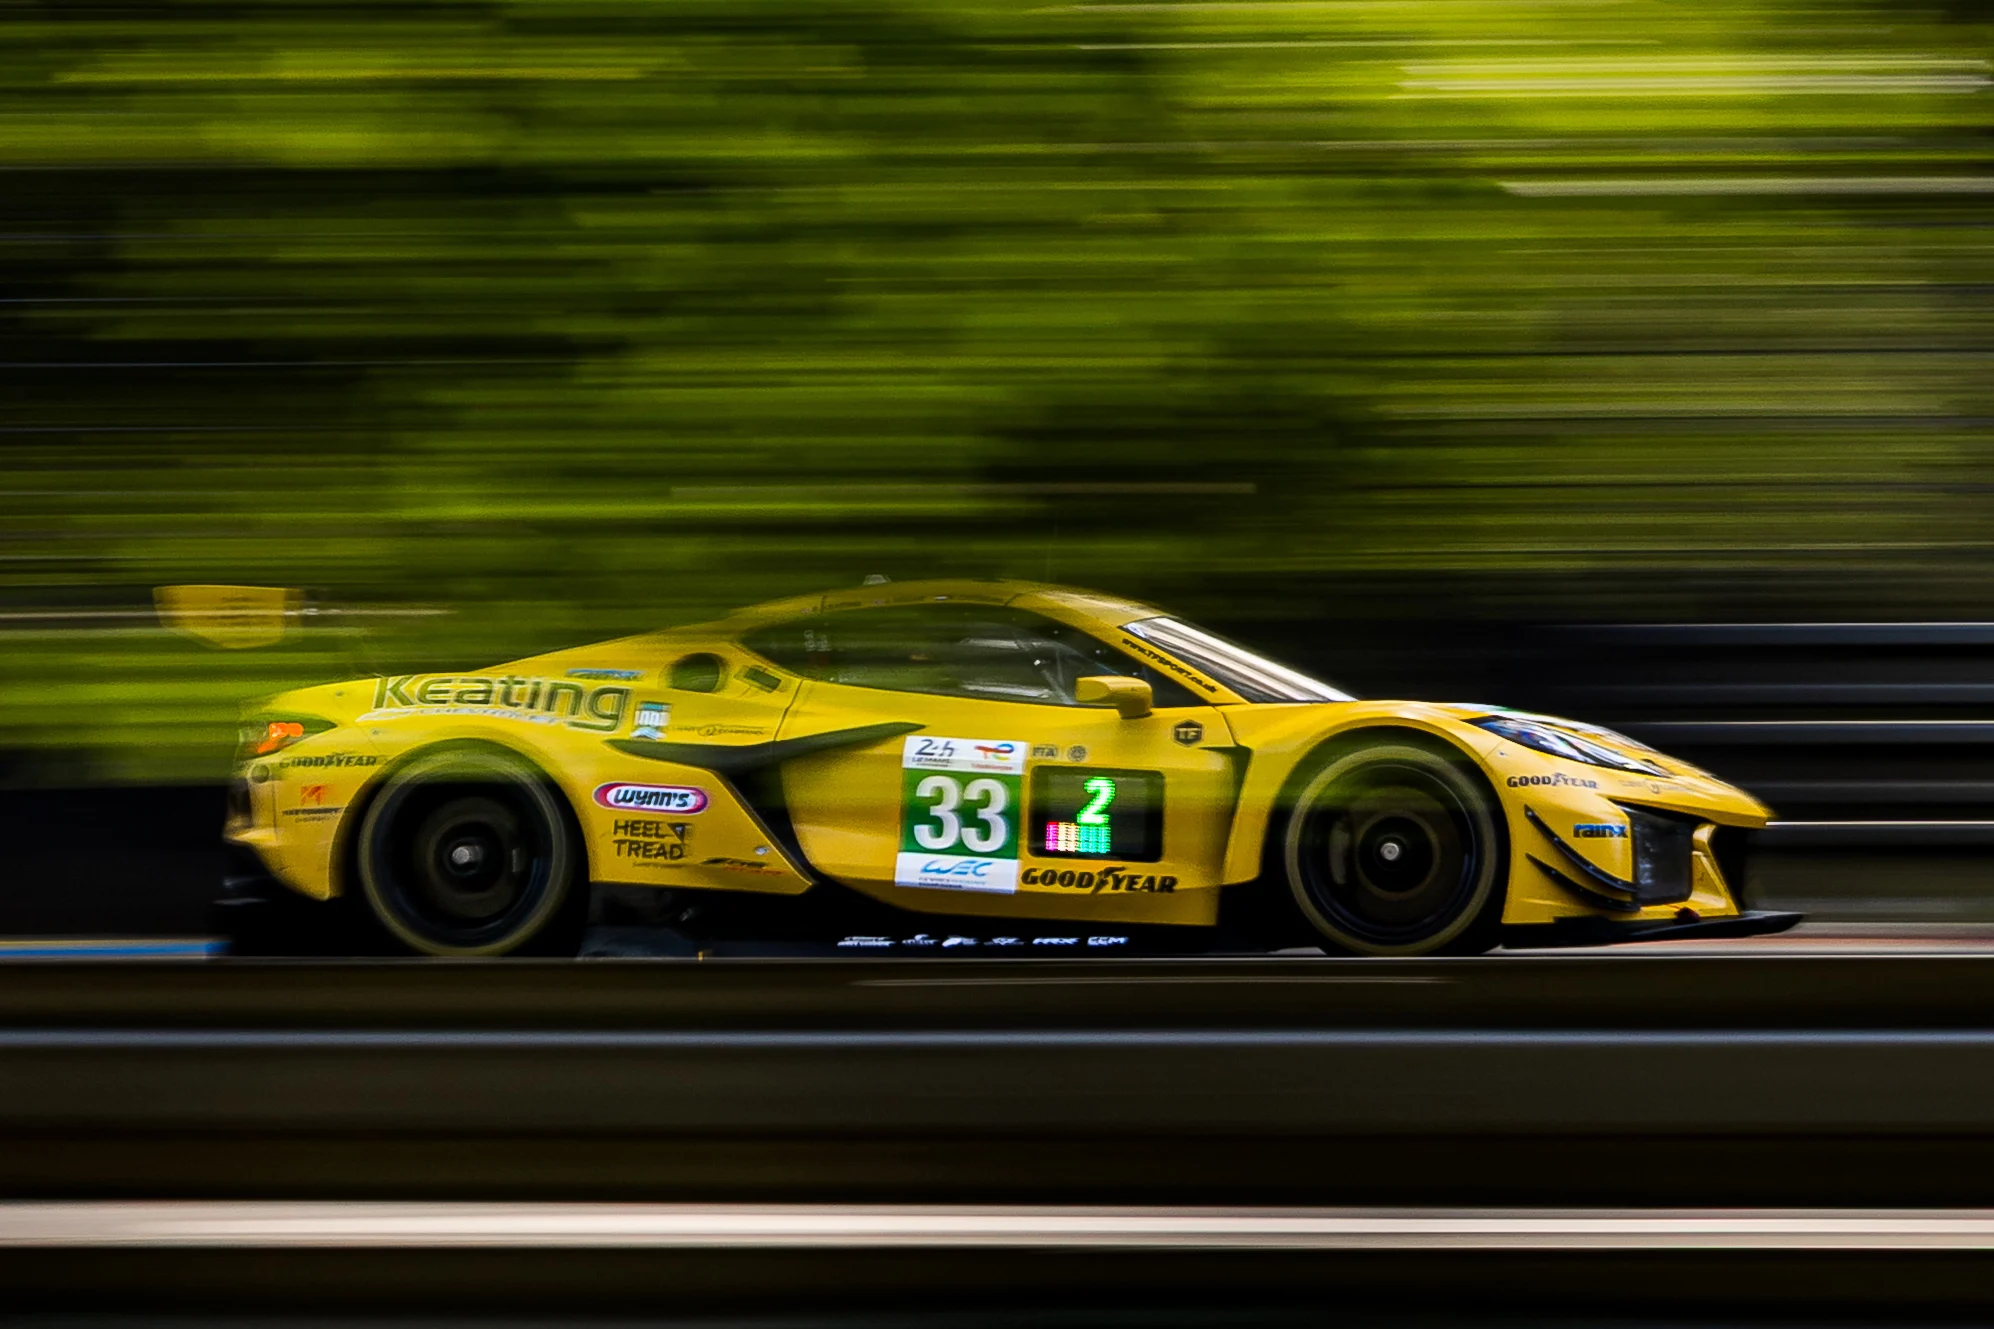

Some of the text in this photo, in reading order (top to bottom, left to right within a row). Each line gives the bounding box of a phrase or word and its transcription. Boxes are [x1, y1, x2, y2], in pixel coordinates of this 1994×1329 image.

[373, 675, 632, 733] Keating
[1506, 773, 1598, 789] GOODYEAR
[914, 775, 1009, 852] 33
[1076, 776, 1116, 824] 2
[613, 819, 670, 838] HEEL
[612, 839, 684, 860] TREAD
[1021, 866, 1178, 894] GOODYEAR
